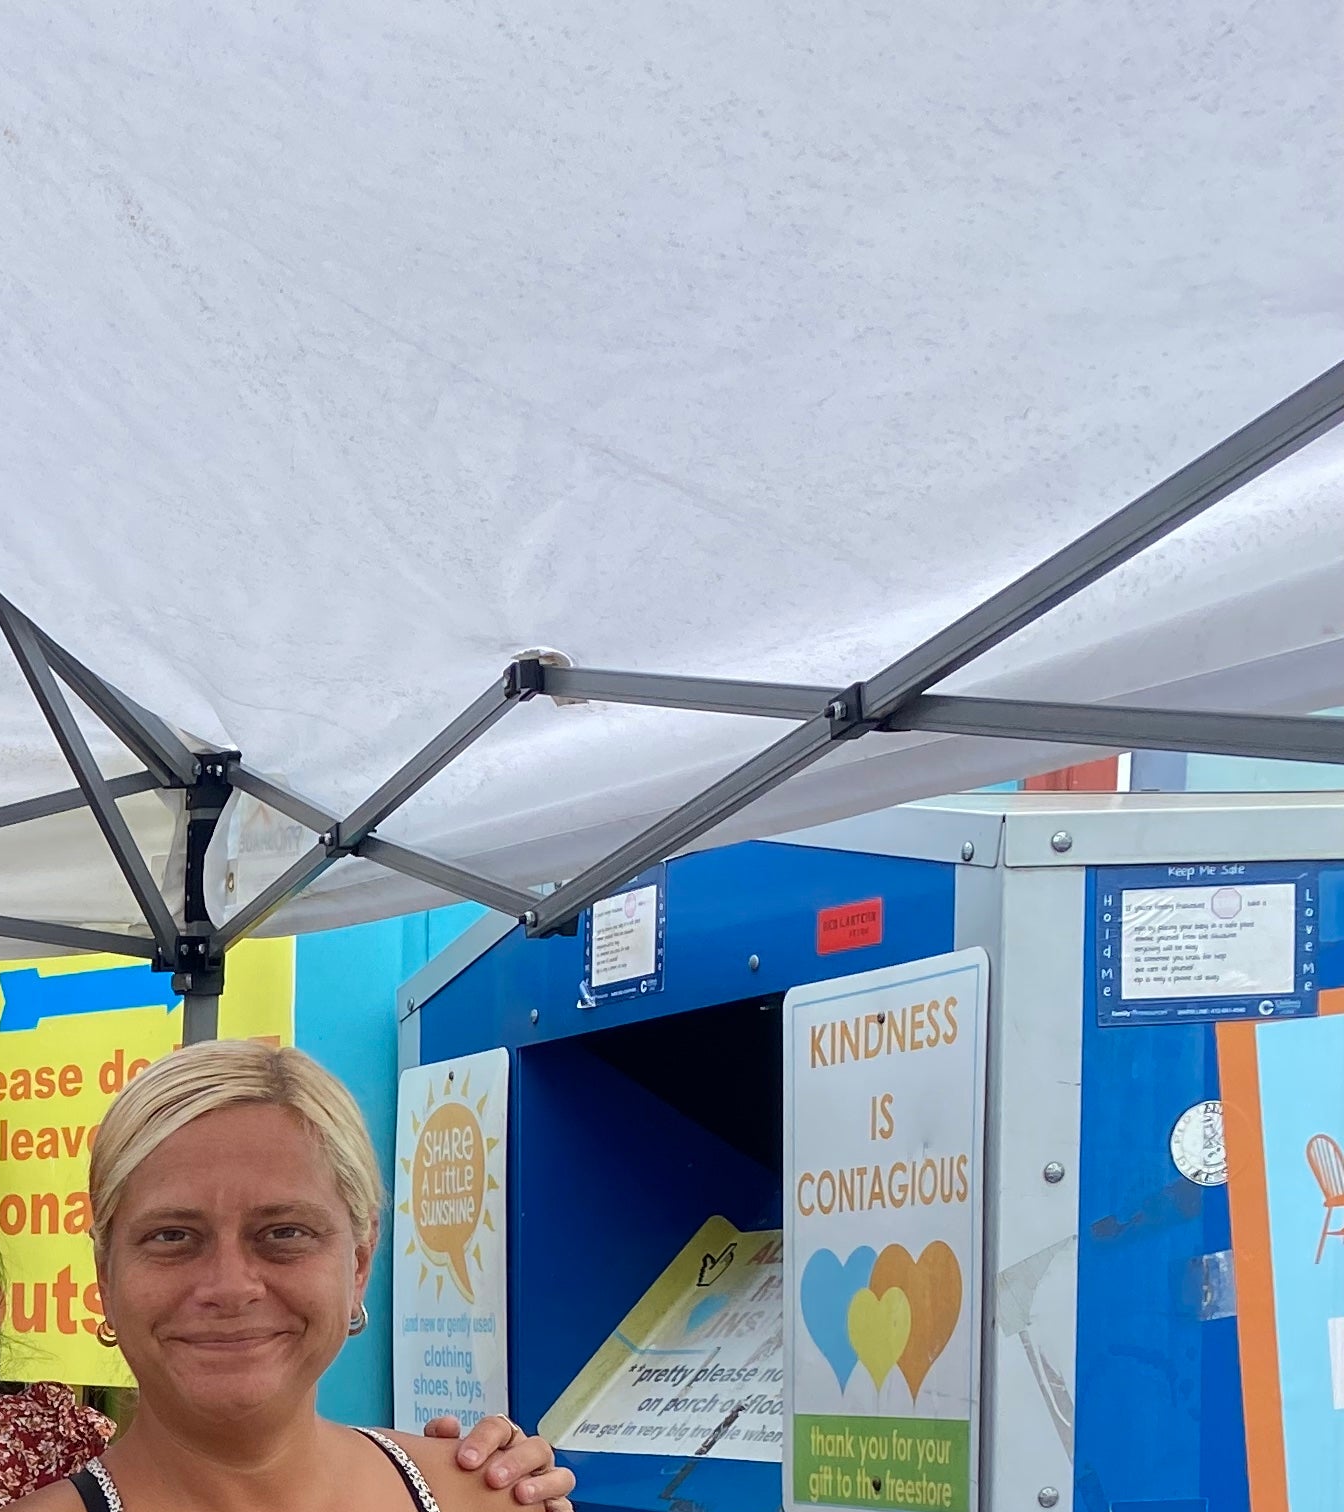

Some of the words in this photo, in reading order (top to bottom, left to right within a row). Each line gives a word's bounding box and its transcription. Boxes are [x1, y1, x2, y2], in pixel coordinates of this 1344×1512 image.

[1168, 866, 1196, 881] Keep
[1199, 865, 1216, 876] Me
[1220, 864, 1246, 876] Safe
[810, 996, 959, 1068] KINDNESS
[870, 1093, 895, 1140] IS
[422, 1170, 430, 1198] A
[797, 1153, 969, 1217] CONTAGIOUS
[424, 1345, 472, 1375] clothing
[413, 1373, 453, 1401] shoes,
[456, 1377, 486, 1404] toys,
[685, 1363, 759, 1388] please
[759, 1368, 783, 1383] no
[637, 1396, 664, 1412] on
[658, 1394, 719, 1417] porch
[745, 1394, 783, 1415] floo
[573, 1419, 598, 1437] (we
[596, 1422, 623, 1438] get
[622, 1422, 639, 1434] in
[639, 1425, 666, 1440] very
[689, 1425, 739, 1441] trole
[810, 1425, 855, 1459] thank
[859, 1433, 889, 1466] you
[892, 1428, 914, 1460] for
[916, 1437, 952, 1467] your
[809, 1466, 833, 1504] gift
[836, 1470, 852, 1498] to
[855, 1466, 882, 1500] the
[885, 1470, 953, 1508] freestore
